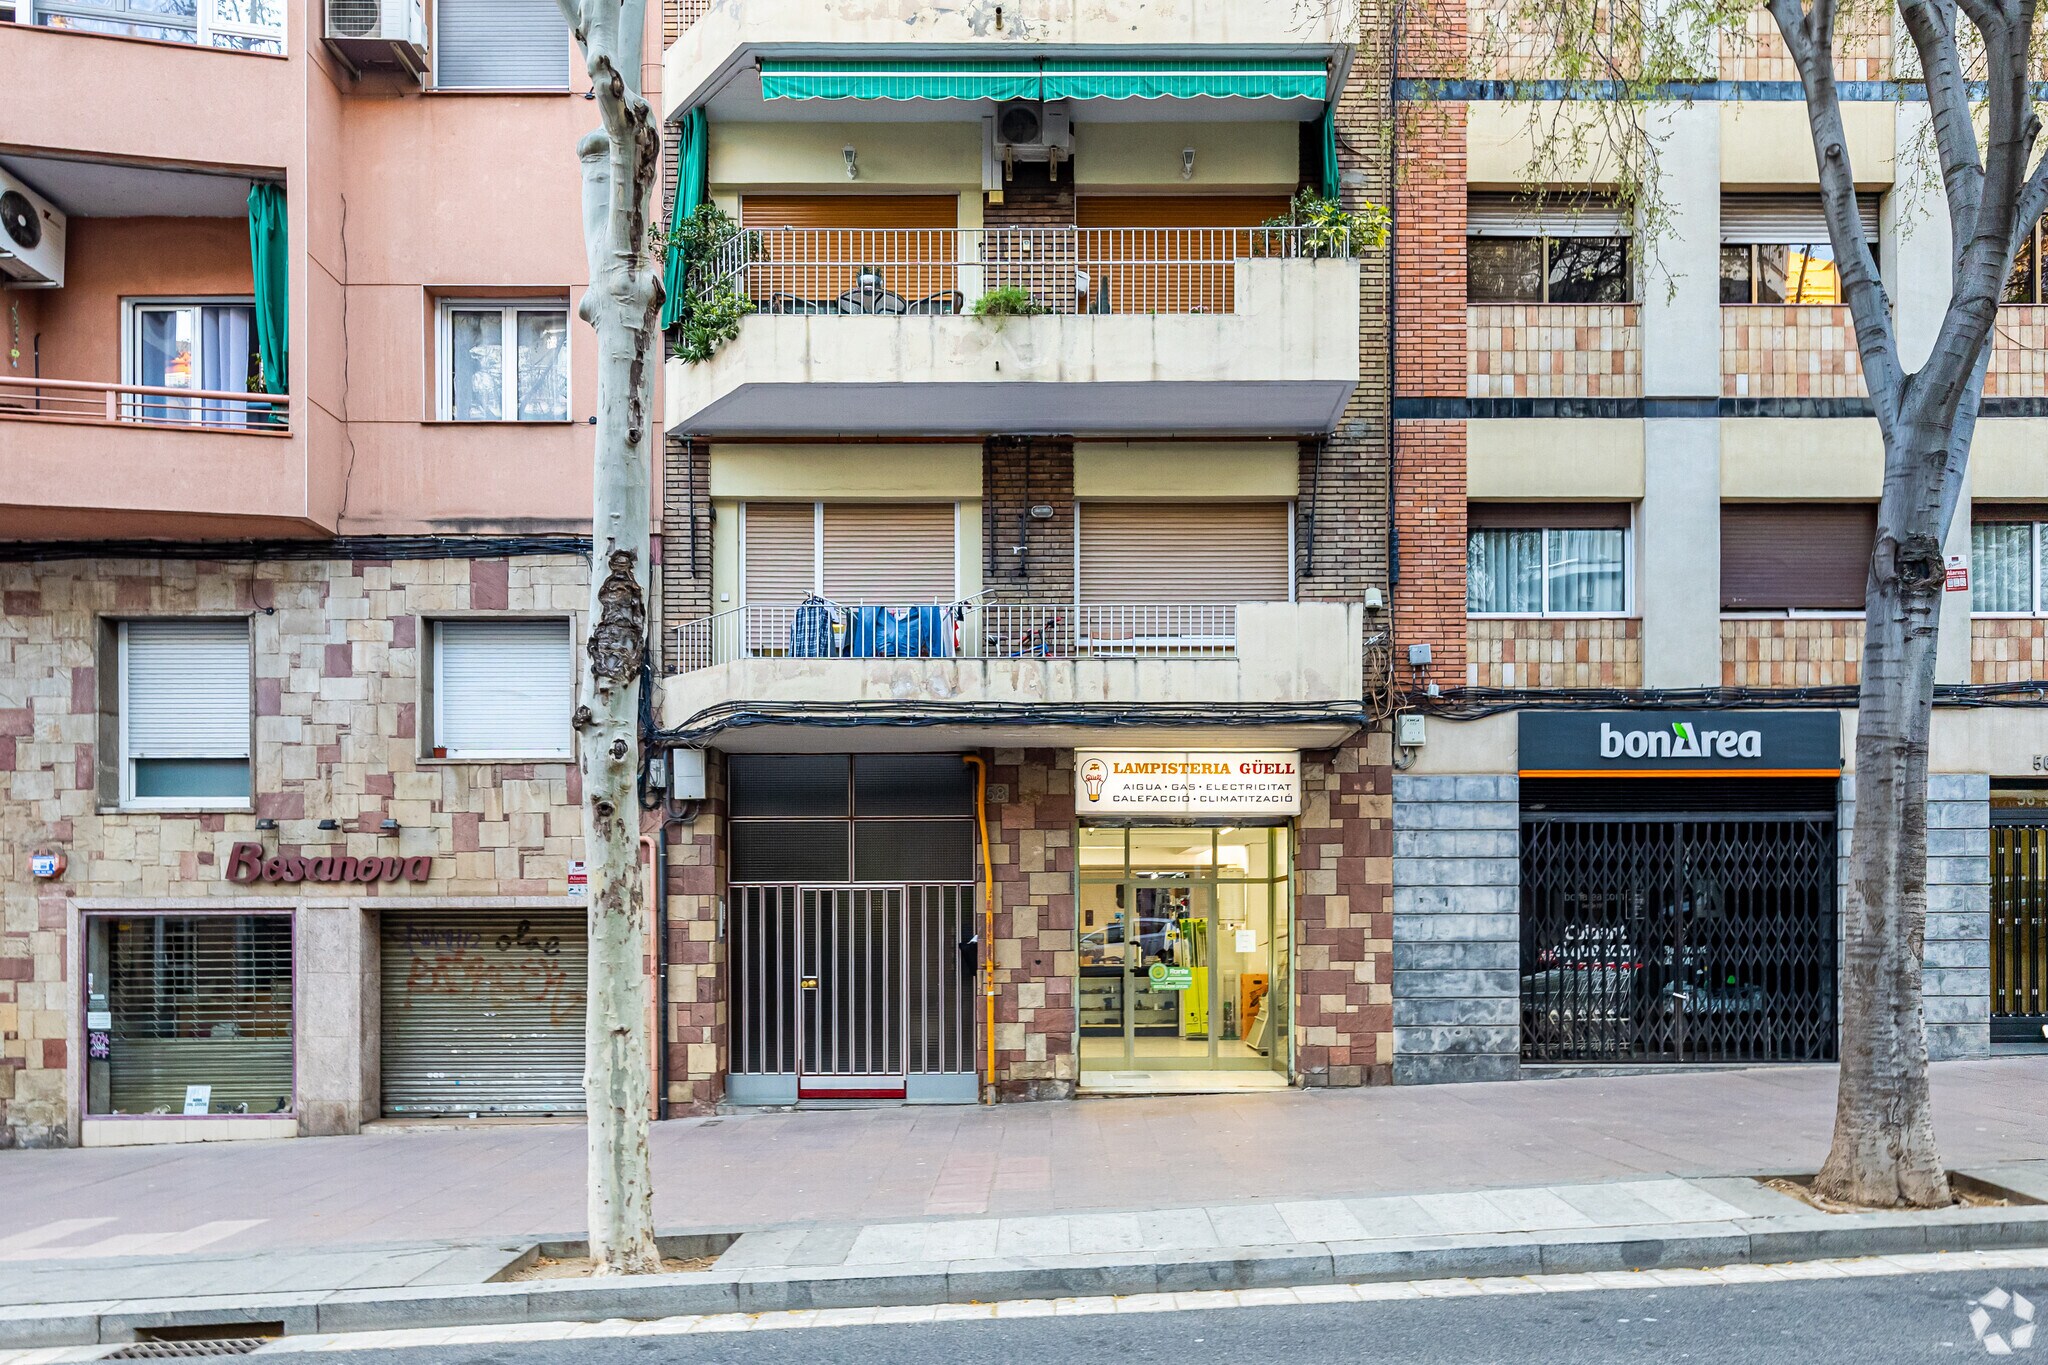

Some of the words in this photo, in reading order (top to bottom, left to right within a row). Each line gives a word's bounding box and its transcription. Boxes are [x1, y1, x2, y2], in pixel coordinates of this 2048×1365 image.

[1600, 722, 1762, 758] bonArea
[1113, 762, 1232, 775] LAMPISTERIA
[1239, 759, 1295, 775] GÜELL
[1123, 783, 1162, 791] AIGUA
[1171, 783, 1196, 791] GAS
[1206, 783, 1292, 791] ELECTRICITAT
[1112, 793, 1190, 803] CALEFACCIÓ
[1199, 793, 1293, 803] CLIMATITZACIÓ
[225, 841, 433, 882] Bosanova
